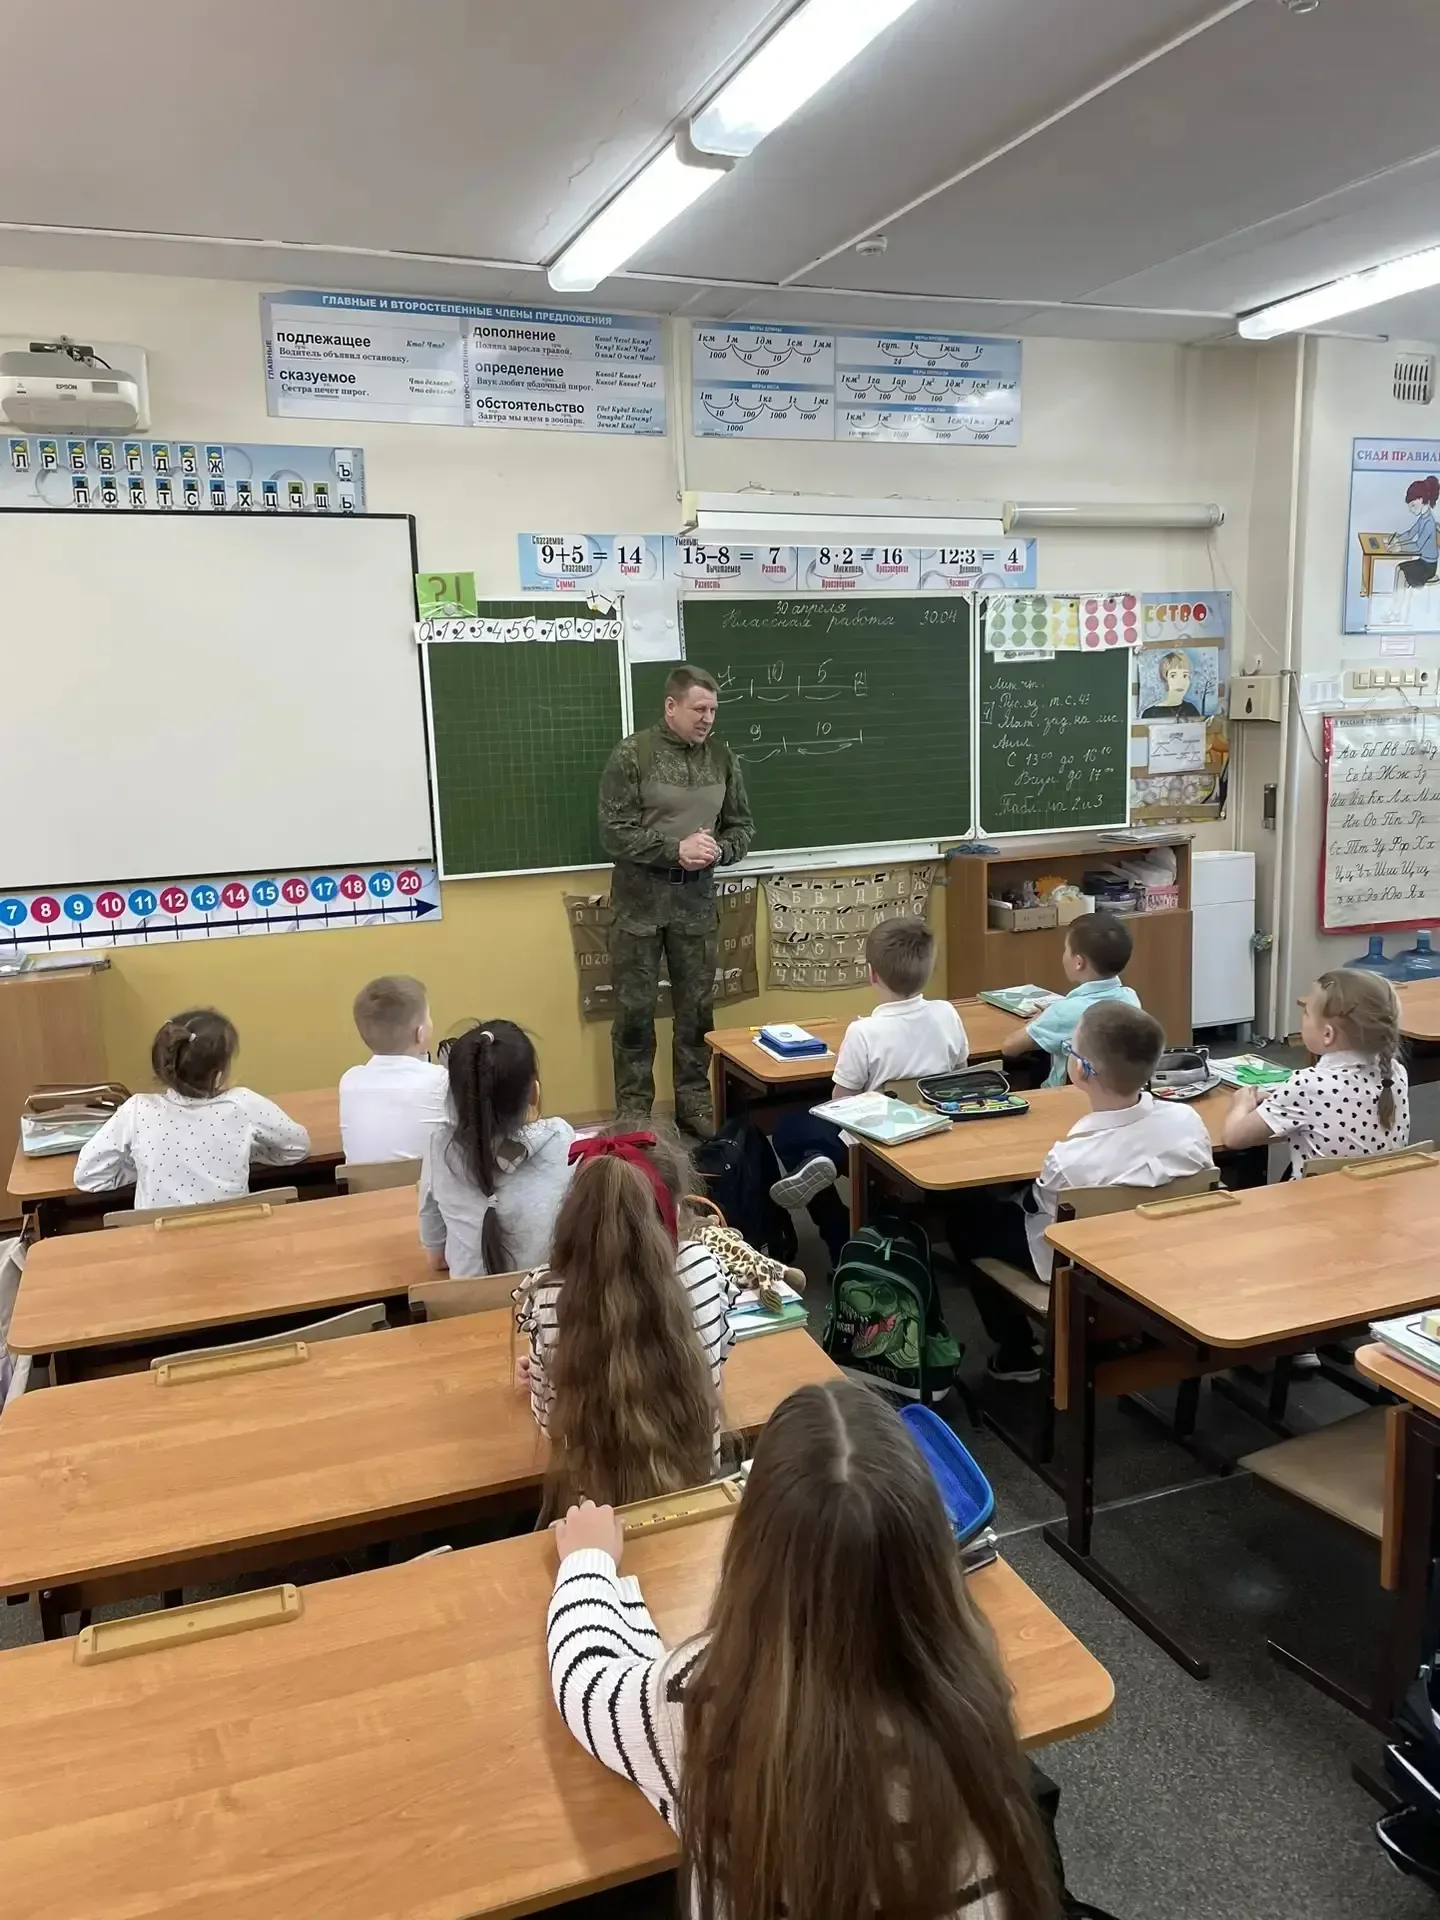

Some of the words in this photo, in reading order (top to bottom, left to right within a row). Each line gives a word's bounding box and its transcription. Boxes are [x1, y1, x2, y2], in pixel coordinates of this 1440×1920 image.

[322, 296, 376, 308] ГЛАВНЫЕ
[380, 300, 388, 308] И
[391, 300, 492, 316] ВТОРОСТЕПЕННЫЕ
[496, 308, 532, 319] ЧЛЕНЫ
[536, 312, 612, 325] ПРЕДЛОЖЕНИЯ
[276, 332, 371, 348] подлежащее
[473, 327, 556, 342] дополнение
[279, 347, 322, 358] Водитель
[323, 350, 361, 361] объявил
[362, 353, 409, 364] остановку.
[476, 341, 506, 351] Поляна
[508, 344, 540, 354] заросла
[542, 346, 572, 357] травой.
[266, 340, 274, 380] ГЛАВНЫЕ
[709, 352, 727, 360] 1000
[743, 352, 752, 361] 10
[773, 354, 782, 362] 10
[802, 356, 812, 364] 10
[279, 370, 356, 384] сказуемое
[475, 363, 564, 378] определение
[756, 368, 770, 376] 100
[281, 384, 312, 394] Сестра
[314, 386, 340, 396] печет
[341, 388, 370, 398] пирог.
[499, 379, 524, 388] любит
[568, 383, 594, 392] пирог.
[476, 397, 584, 414] обстоятельство
[478, 412, 507, 422] Завтра
[508, 414, 522, 422] мы
[523, 414, 544, 423] идем
[551, 416, 585, 426] зоопарк.
[716, 409, 724, 417] 10
[742, 410, 756, 418] 100
[770, 412, 787, 420] 1000
[799, 412, 816, 420] 1000
[726, 424, 744, 432] 1000
[1357, 450, 1388, 460] СИДИ
[16, 454, 26, 468] Л
[44, 456, 54, 468] Р
[73, 456, 84, 468] Б
[101, 457, 112, 468] В
[129, 458, 138, 470] Г
[156, 460, 168, 472] Д
[184, 460, 194, 472] З
[210, 460, 222, 472] Ж
[338, 464, 350, 476] Ъ
[76, 490, 88, 503] П
[104, 490, 116, 503] Ф
[133, 492, 144, 504] К
[160, 492, 170, 504] Т
[186, 492, 196, 505] С
[213, 494, 224, 506] Ш
[240, 494, 250, 506] Х
[266, 494, 276, 508] Ц
[291, 495, 302, 508] Ч
[316, 496, 328, 508] Щ
[342, 497, 352, 508] Ь
[532, 536, 564, 546] Слагаемое
[542, 545, 584, 564] 9+5
[618, 546, 642, 564] 14
[769, 547, 780, 564] 7
[882, 548, 903, 564] 16
[940, 549, 976, 564] 12:3
[1008, 548, 1018, 564] 4
[562, 564, 592, 573] Слагаемое
[620, 564, 640, 575] Сумма
[706, 564, 740, 573] Вычитаемое
[762, 564, 786, 573] Разность
[556, 580, 576, 591] Сумма
[694, 580, 720, 588] Разность
[776, 600, 789, 614] 30
[792, 602, 846, 619] апреля
[722, 608, 812, 628] Классная
[826, 608, 896, 634] работа
[920, 609, 957, 626] 30.04
[420, 622, 430, 641] 0
[441, 622, 450, 640] 1
[453, 621, 466, 639] 2
[472, 620, 484, 638] 3
[491, 621, 502, 639] 4
[509, 621, 520, 639] 5
[524, 620, 534, 638] 6
[545, 622, 555, 640] 7
[560, 620, 572, 638] 8
[580, 622, 592, 639] 9
[603, 621, 622, 638] 10
[818, 658, 832, 683] 5
[816, 721, 832, 736] 10
[6, 906, 17, 920] 7
[40, 903, 52, 917] 8
[73, 901, 84, 914] 9
[101, 898, 122, 912] 10
[134, 896, 154, 910] 11
[164, 894, 185, 908] 12
[196, 892, 216, 905] 13
[226, 888, 246, 904] 14
[256, 887, 276, 900] 15
[286, 884, 305, 898] 16
[316, 882, 334, 896] 17
[344, 880, 363, 894] 18
[372, 878, 391, 892] 19
[400, 876, 418, 890] 20
